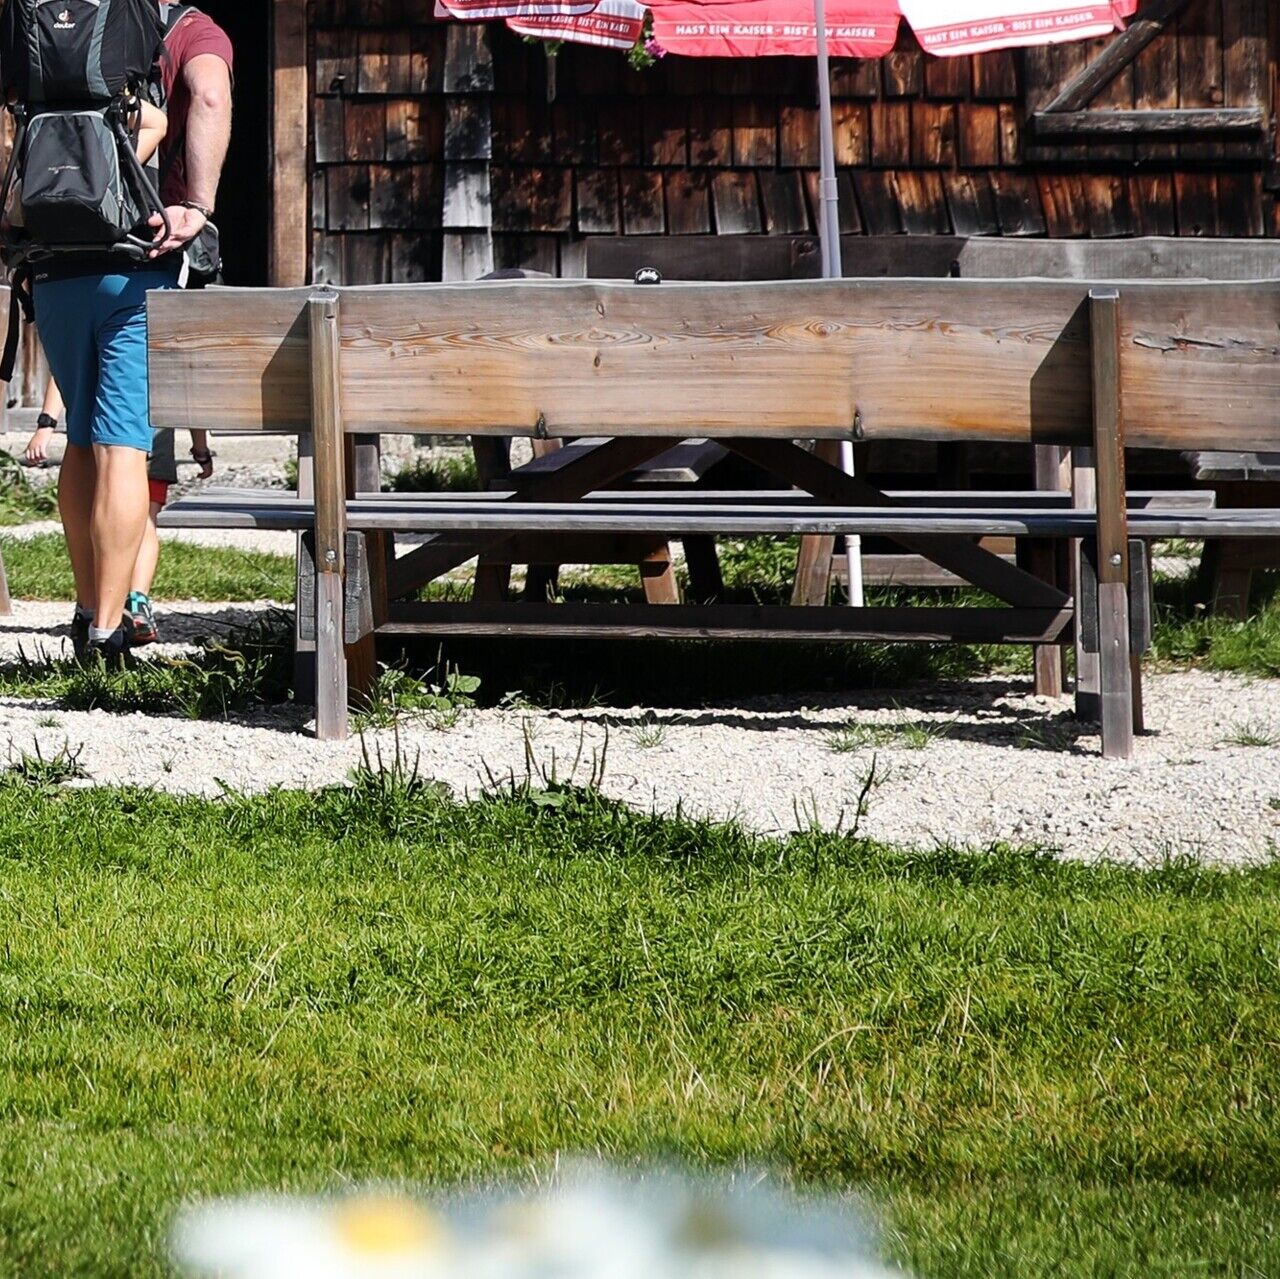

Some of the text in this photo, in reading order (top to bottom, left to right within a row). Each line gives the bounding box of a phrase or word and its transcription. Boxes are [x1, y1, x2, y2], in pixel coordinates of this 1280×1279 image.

[675, 24, 705, 35] HAST
[709, 25, 730, 35] EIN
[733, 25, 773, 36] KAISER
[783, 26, 809, 36] BIST
[836, 27, 876, 38] KAISER
[924, 33, 947, 44] HAST
[950, 29, 967, 41] EIN
[971, 24, 1005, 37] KAISER
[1012, 19, 1033, 31] BIST
[1035, 17, 1053, 29] EIN
[1056, 12, 1094, 26] KAISER
